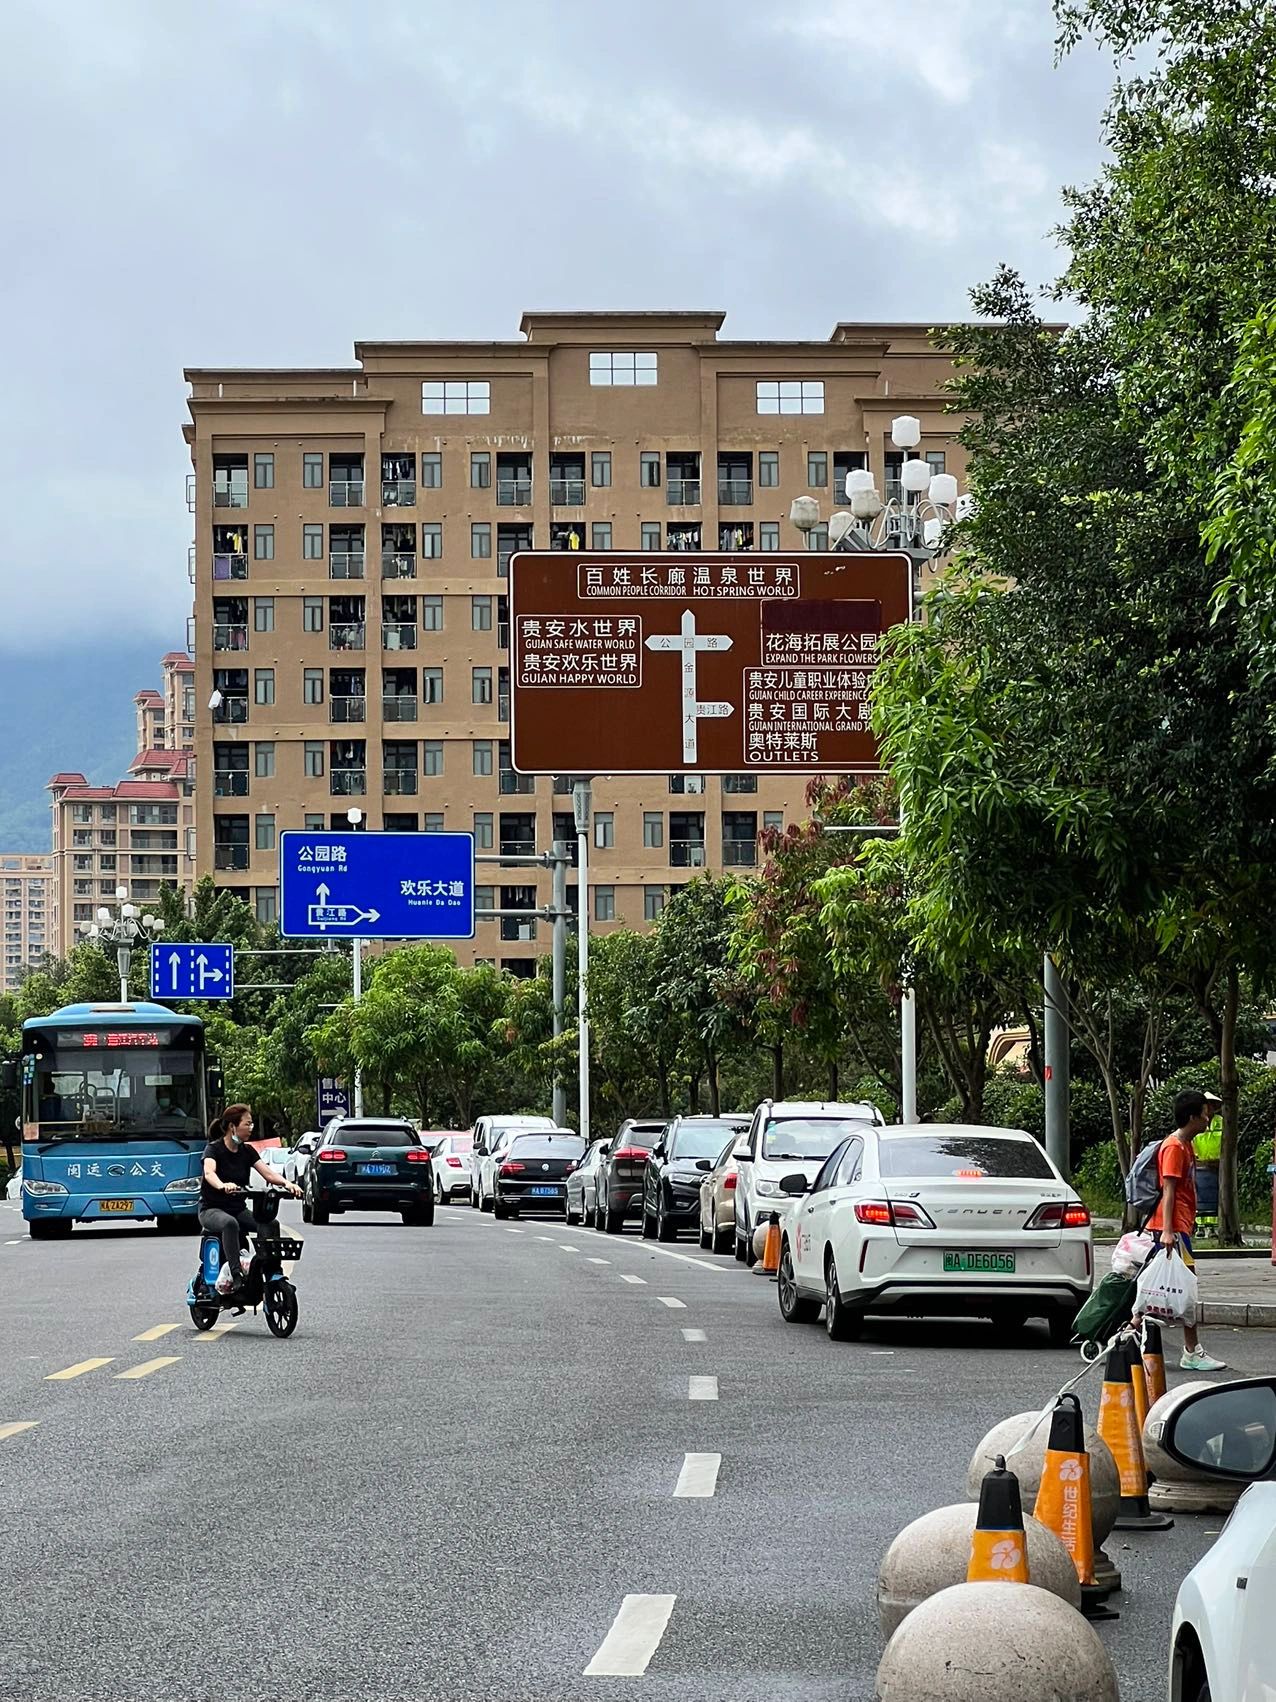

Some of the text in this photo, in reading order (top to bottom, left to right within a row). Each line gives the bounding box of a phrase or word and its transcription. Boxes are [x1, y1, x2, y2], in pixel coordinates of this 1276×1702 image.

[586, 567, 793, 585] 百姓长廊温泉世界
[586, 585, 795, 596] COMMON PEOPLE CORRIDOR HOT SPRING WORLD
[521, 619, 637, 637] 贵安水世界
[525, 639, 635, 649] GUIAN SAFE WATER WORLD
[660, 637, 718, 649] 公园路
[766, 633, 877, 652] 花海拓展公园
[523, 653, 638, 671] 贵安欢乐世界
[765, 653, 878, 664] EXPAND THE PARK FLOWERS
[521, 673, 637, 684] GUIAN HAPPY WORLD
[749, 691, 773, 701] GUIAN
[773, 691, 796, 701] CHILD
[796, 691, 824, 701] CAREER
[824, 691, 867, 701] EXPERIENCE
[696, 704, 729, 715] 贵江路
[748, 702, 874, 721] 贵安国际大剧
[749, 721, 774, 732] GUIAN
[774, 721, 834, 732] INTERNATIONAL
[835, 721, 863, 732] GRAND
[748, 732, 818, 750] 奥特莱斯
[750, 751, 819, 762] OUTLETS
[298, 845, 348, 862] 公园路
[297, 864, 348, 874] Gongyuan Rd
[400, 880, 465, 897] 欢乐大道
[322, 1092, 347, 1104] 中心
[67, 1161, 166, 1178] 闽运 公交
